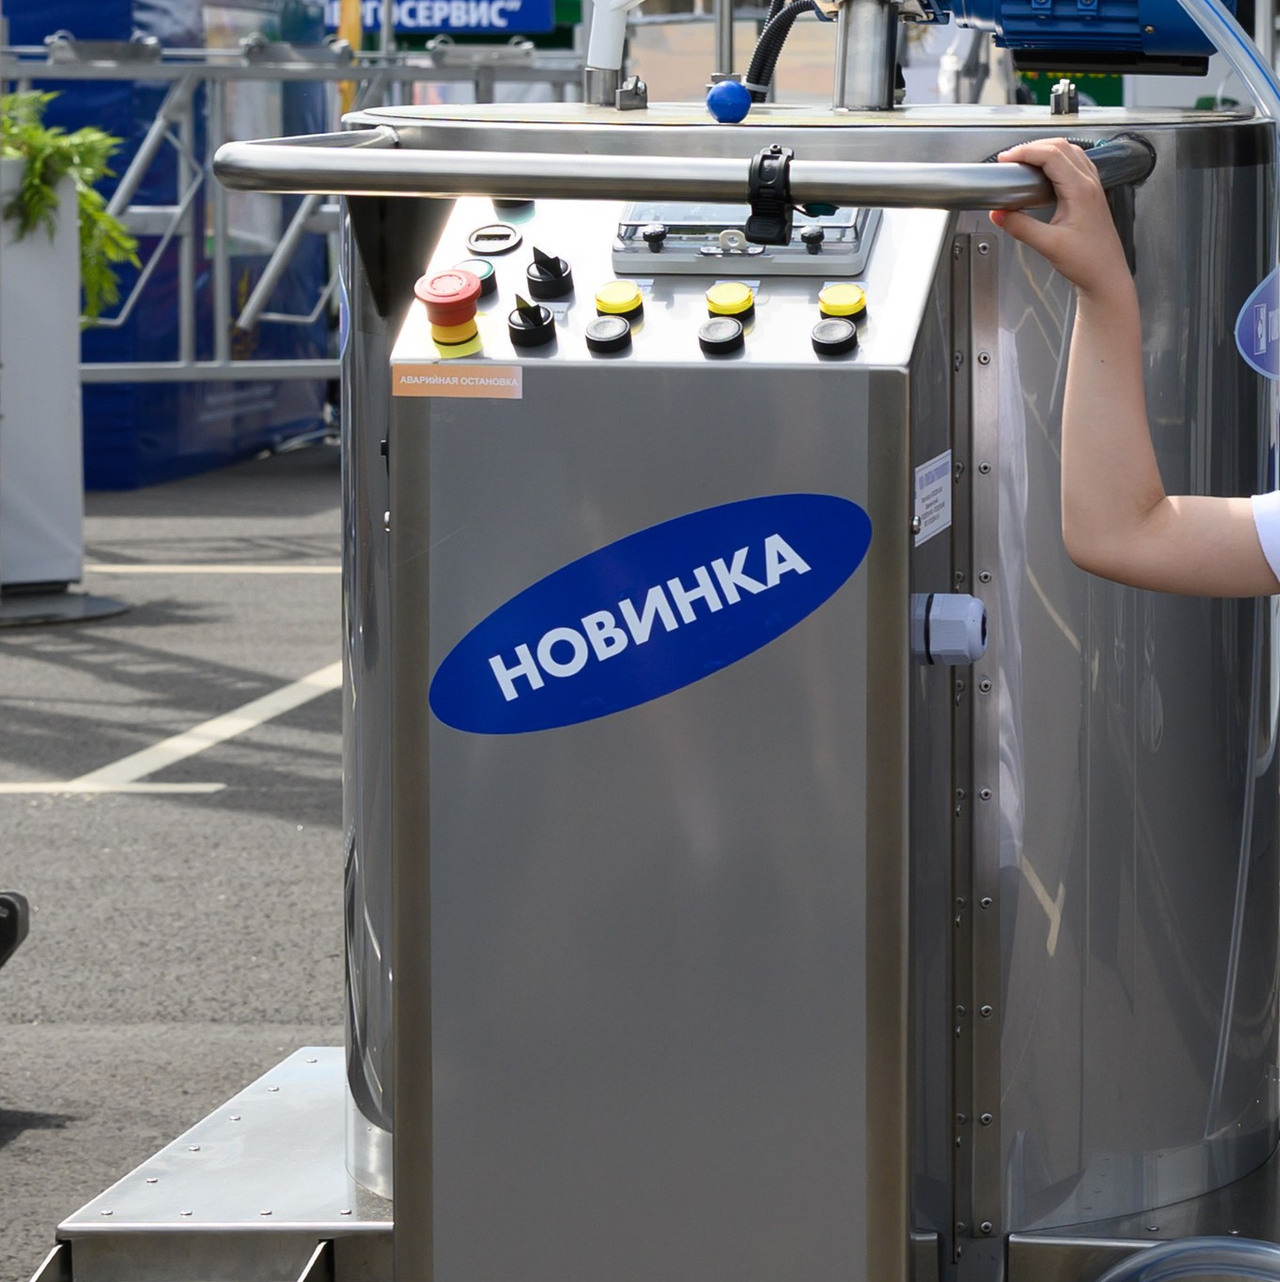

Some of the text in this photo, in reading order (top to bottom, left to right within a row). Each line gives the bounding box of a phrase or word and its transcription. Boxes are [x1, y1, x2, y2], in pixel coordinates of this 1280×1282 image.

[400, 374, 518, 387] АВАРИЙНАЯ ОСТАНОВКА
[488, 533, 812, 702] НОВИНКА
